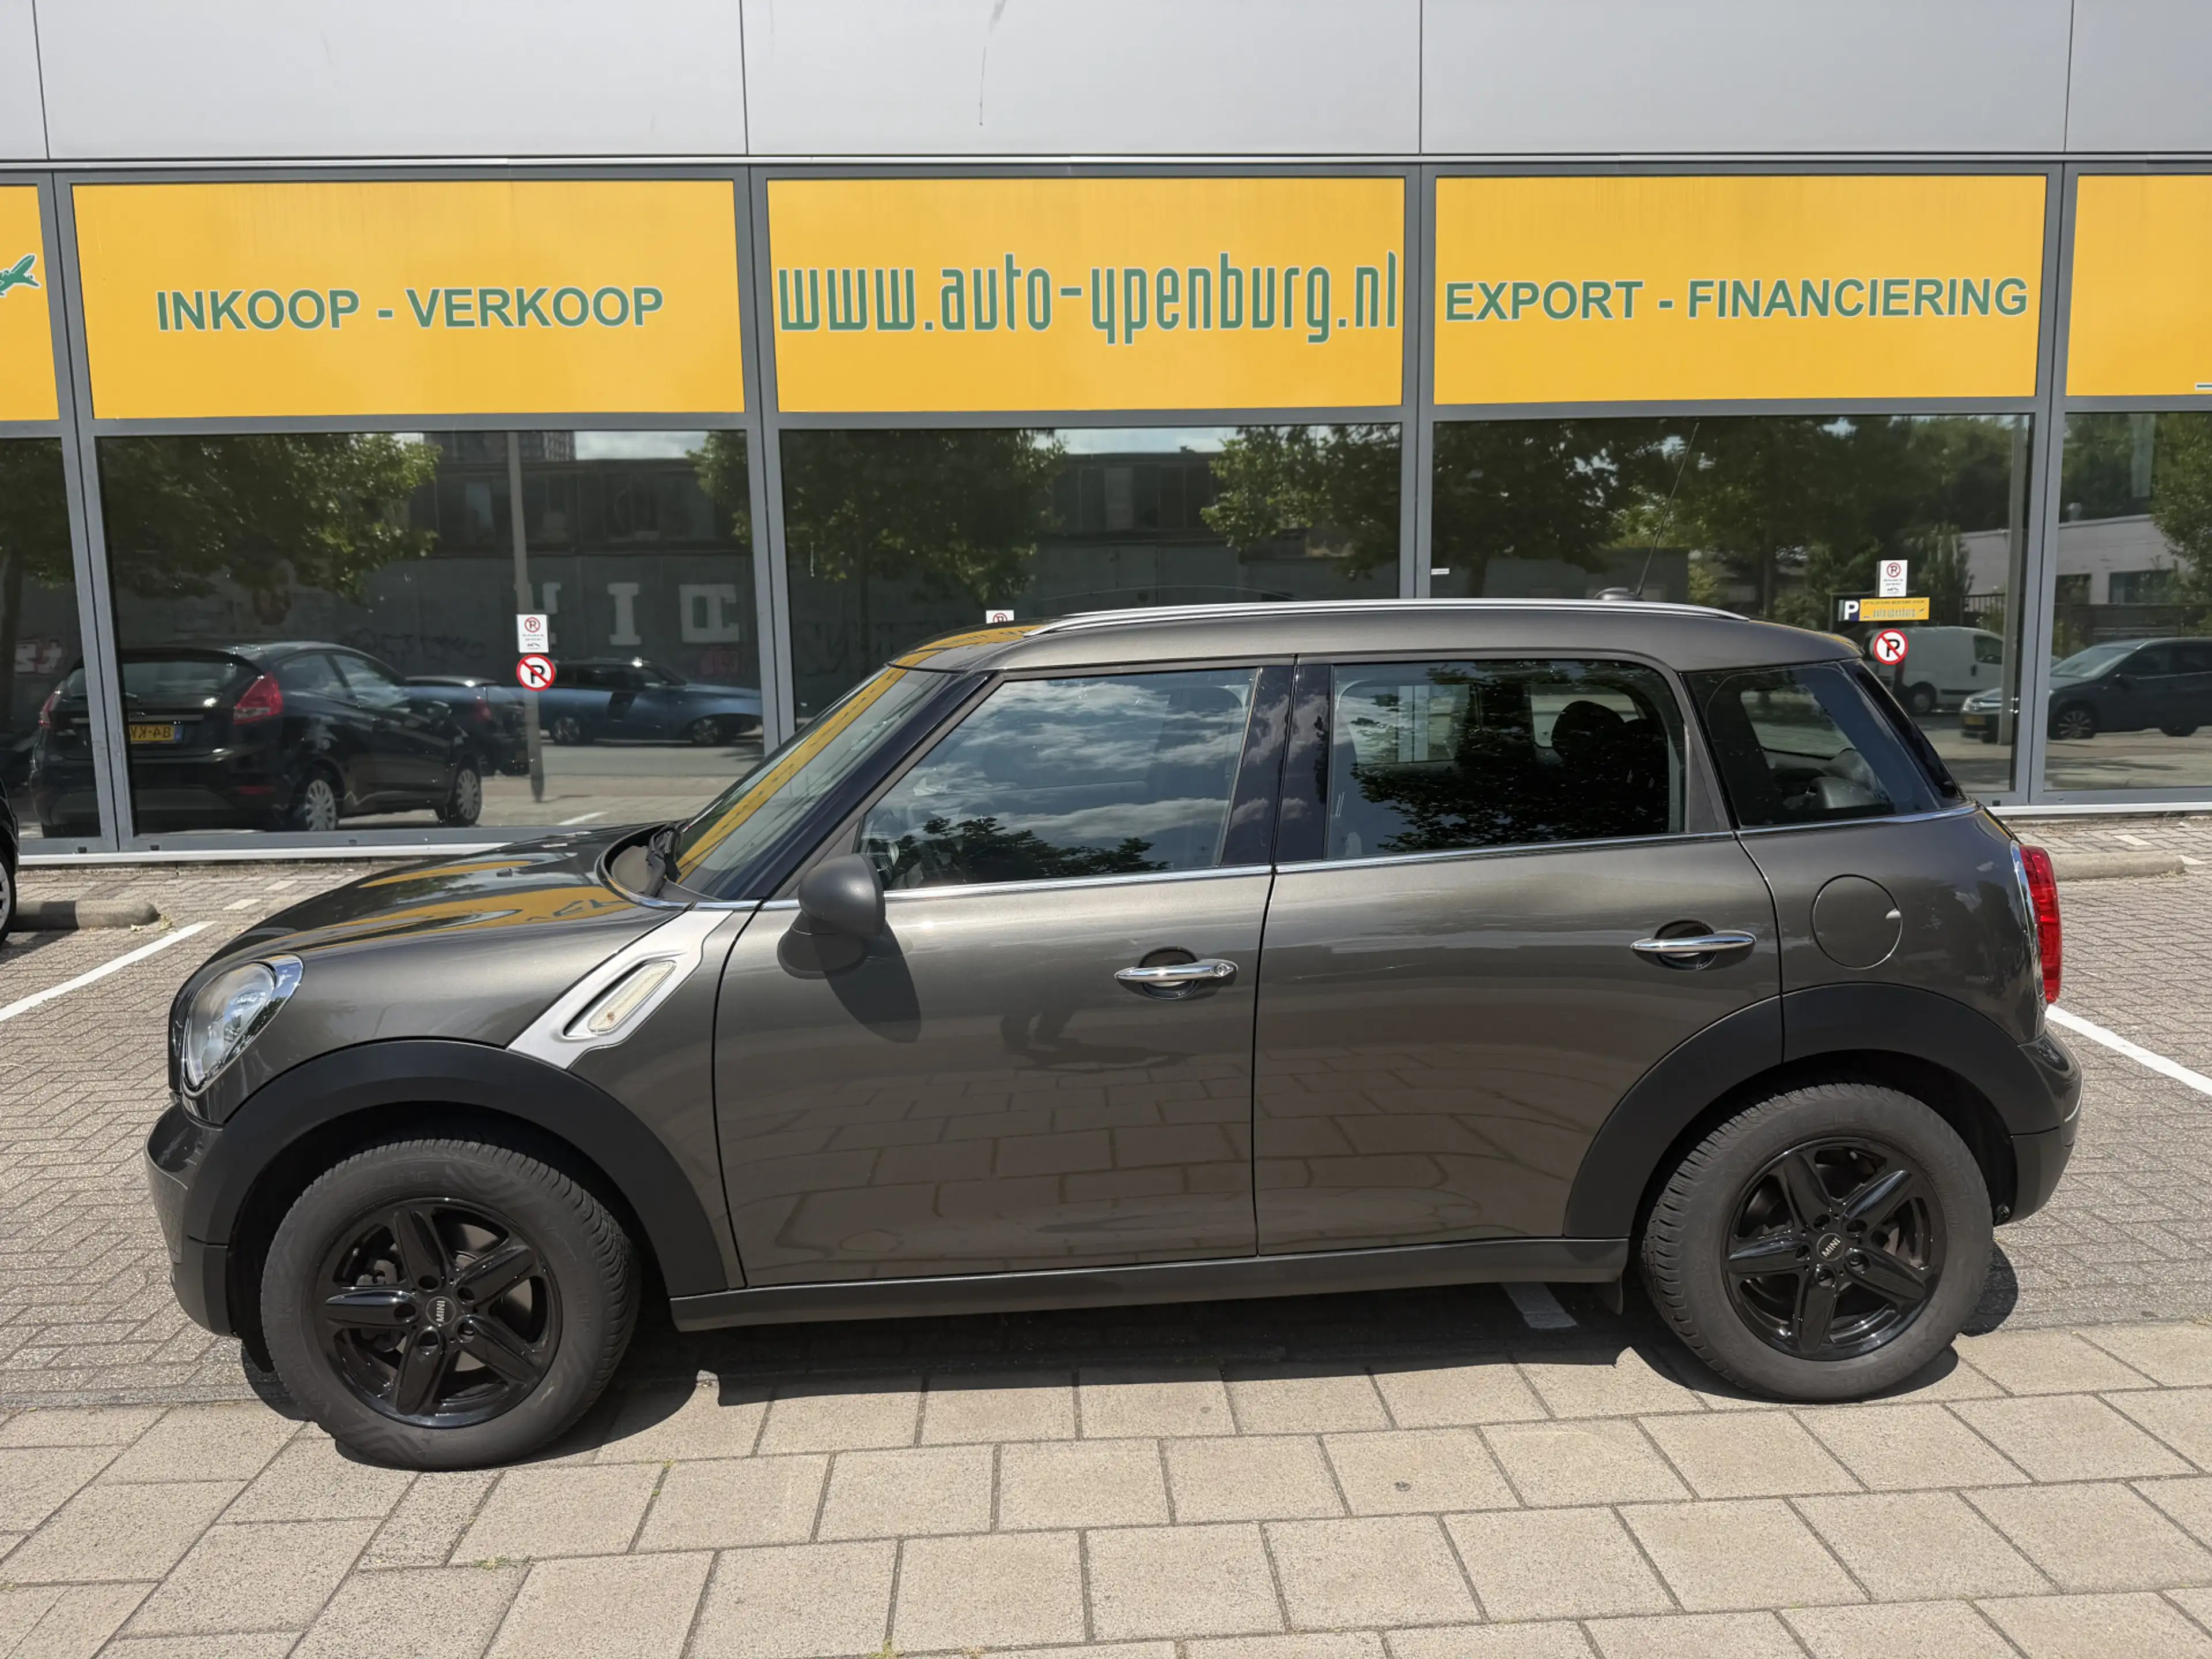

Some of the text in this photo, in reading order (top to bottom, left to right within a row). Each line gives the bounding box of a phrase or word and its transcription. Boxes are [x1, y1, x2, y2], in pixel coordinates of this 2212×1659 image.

[157, 290, 359, 330] INKOOP
[406, 287, 663, 327] VERKOOP
[775, 252, 1396, 344] www.auto-ypenburg.nl
[1445, 281, 1643, 320] EXPORT
[1689, 278, 2028, 317] FINANCIERING
[1843, 600, 1859, 620] P
[1821, 1237, 1841, 1257] MINI
[435, 1300, 446, 1323] MINI
